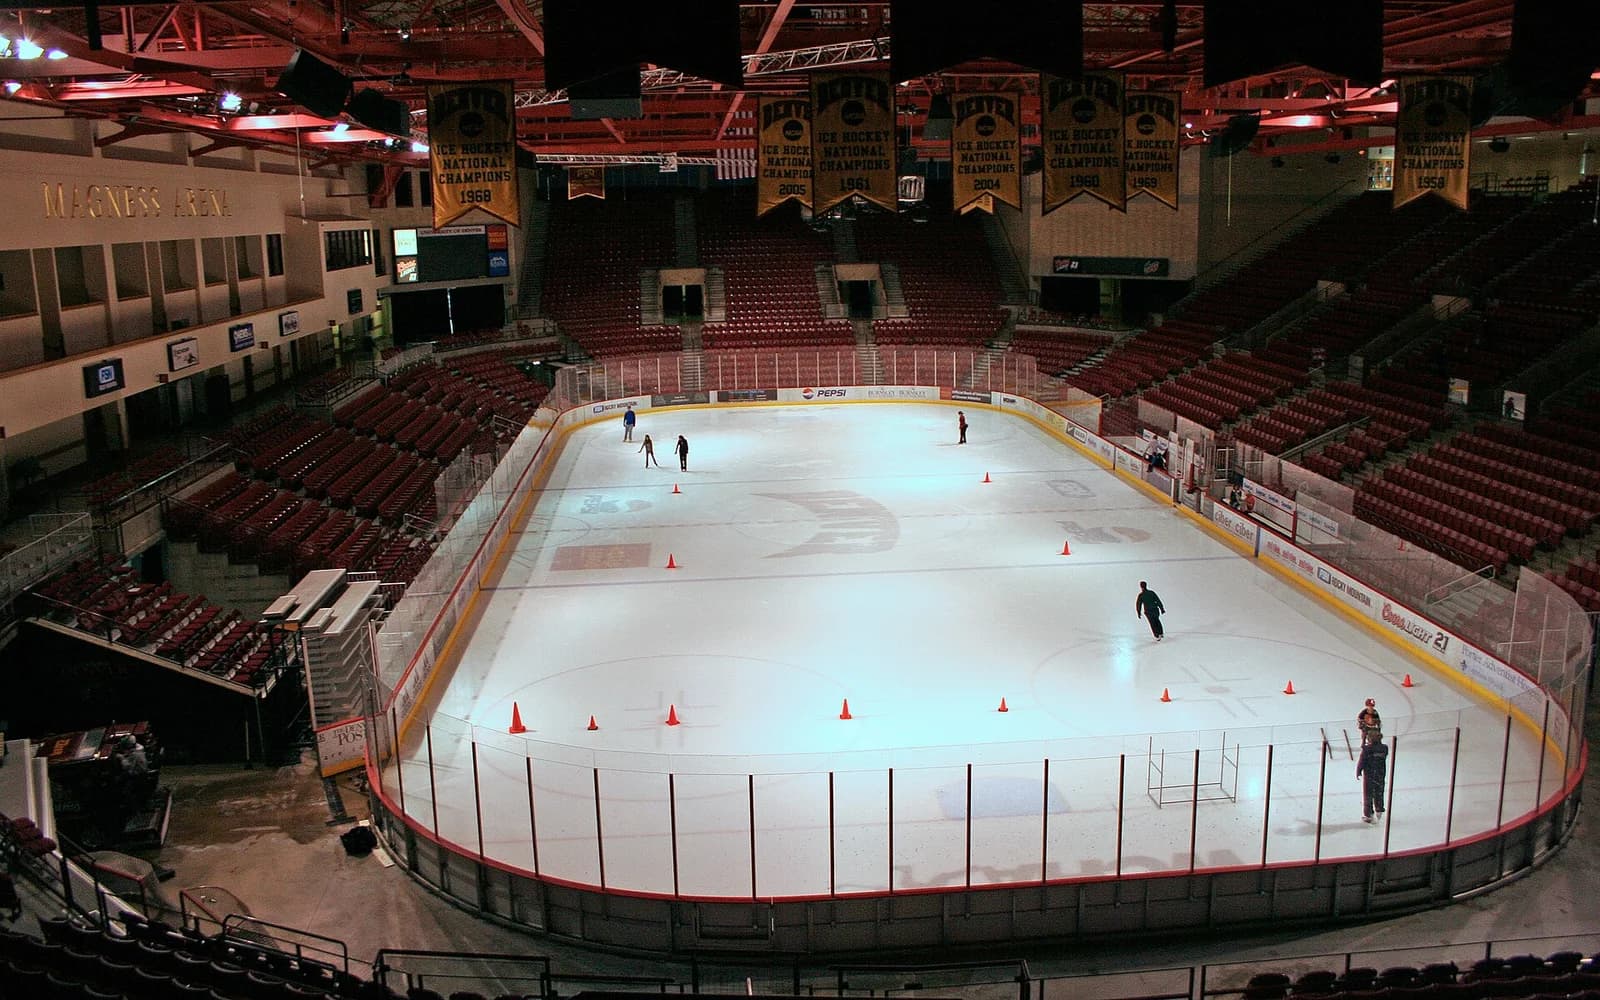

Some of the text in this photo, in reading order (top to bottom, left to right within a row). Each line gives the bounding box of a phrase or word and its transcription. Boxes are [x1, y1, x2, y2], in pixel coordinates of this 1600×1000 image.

[818, 130, 889, 143] ICE HOCKEY
[437, 144, 457, 155] ICE
[957, 141, 1016, 151] ICE HOCKEY
[1055, 143, 1115, 154] NATIONAL
[1137, 139, 1175, 149] HOCKEY
[763, 146, 779, 155] ICE
[824, 145, 885, 157] NATIONAL
[1407, 145, 1461, 156] NATIONAL
[961, 153, 1011, 162] NATIONAL
[1051, 157, 1119, 168] CHAMPIONS
[443, 157, 507, 170] NATIONAL
[819, 160, 890, 171] CHAMPIONS
[958, 164, 1015, 174] CHAMPIONS
[1402, 158, 1464, 169] CHAMPIONS
[439, 171, 511, 184] CHAMPIONS
[779, 184, 806, 195] 2005
[974, 179, 1000, 190] 2004
[40, 181, 232, 218] MAGNESS ARENA
[817, 389, 847, 397] PEPSI
[1235, 521, 1254, 541] ciber
[1332, 576, 1346, 592] ROCKY
[1346, 588, 1371, 607] MOUNTAIN
[1382, 603, 1449, 650] Coors LIGHT 21
